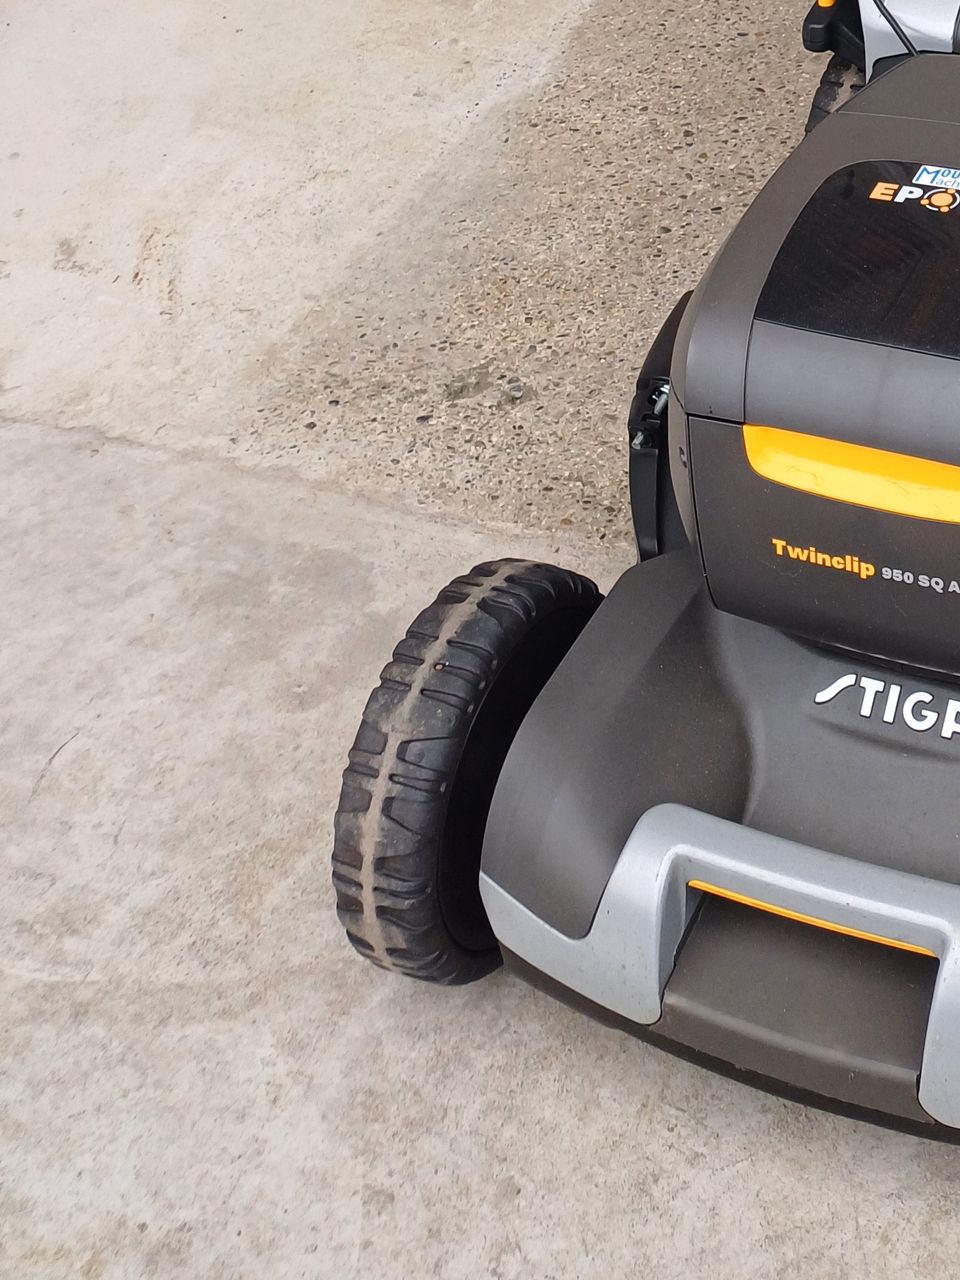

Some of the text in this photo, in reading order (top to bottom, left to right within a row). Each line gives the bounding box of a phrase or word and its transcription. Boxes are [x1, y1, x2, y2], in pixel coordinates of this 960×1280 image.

[771, 538, 875, 579] Twinclip
[881, 567, 914, 584] 950
[918, 575, 944, 594] SQ
